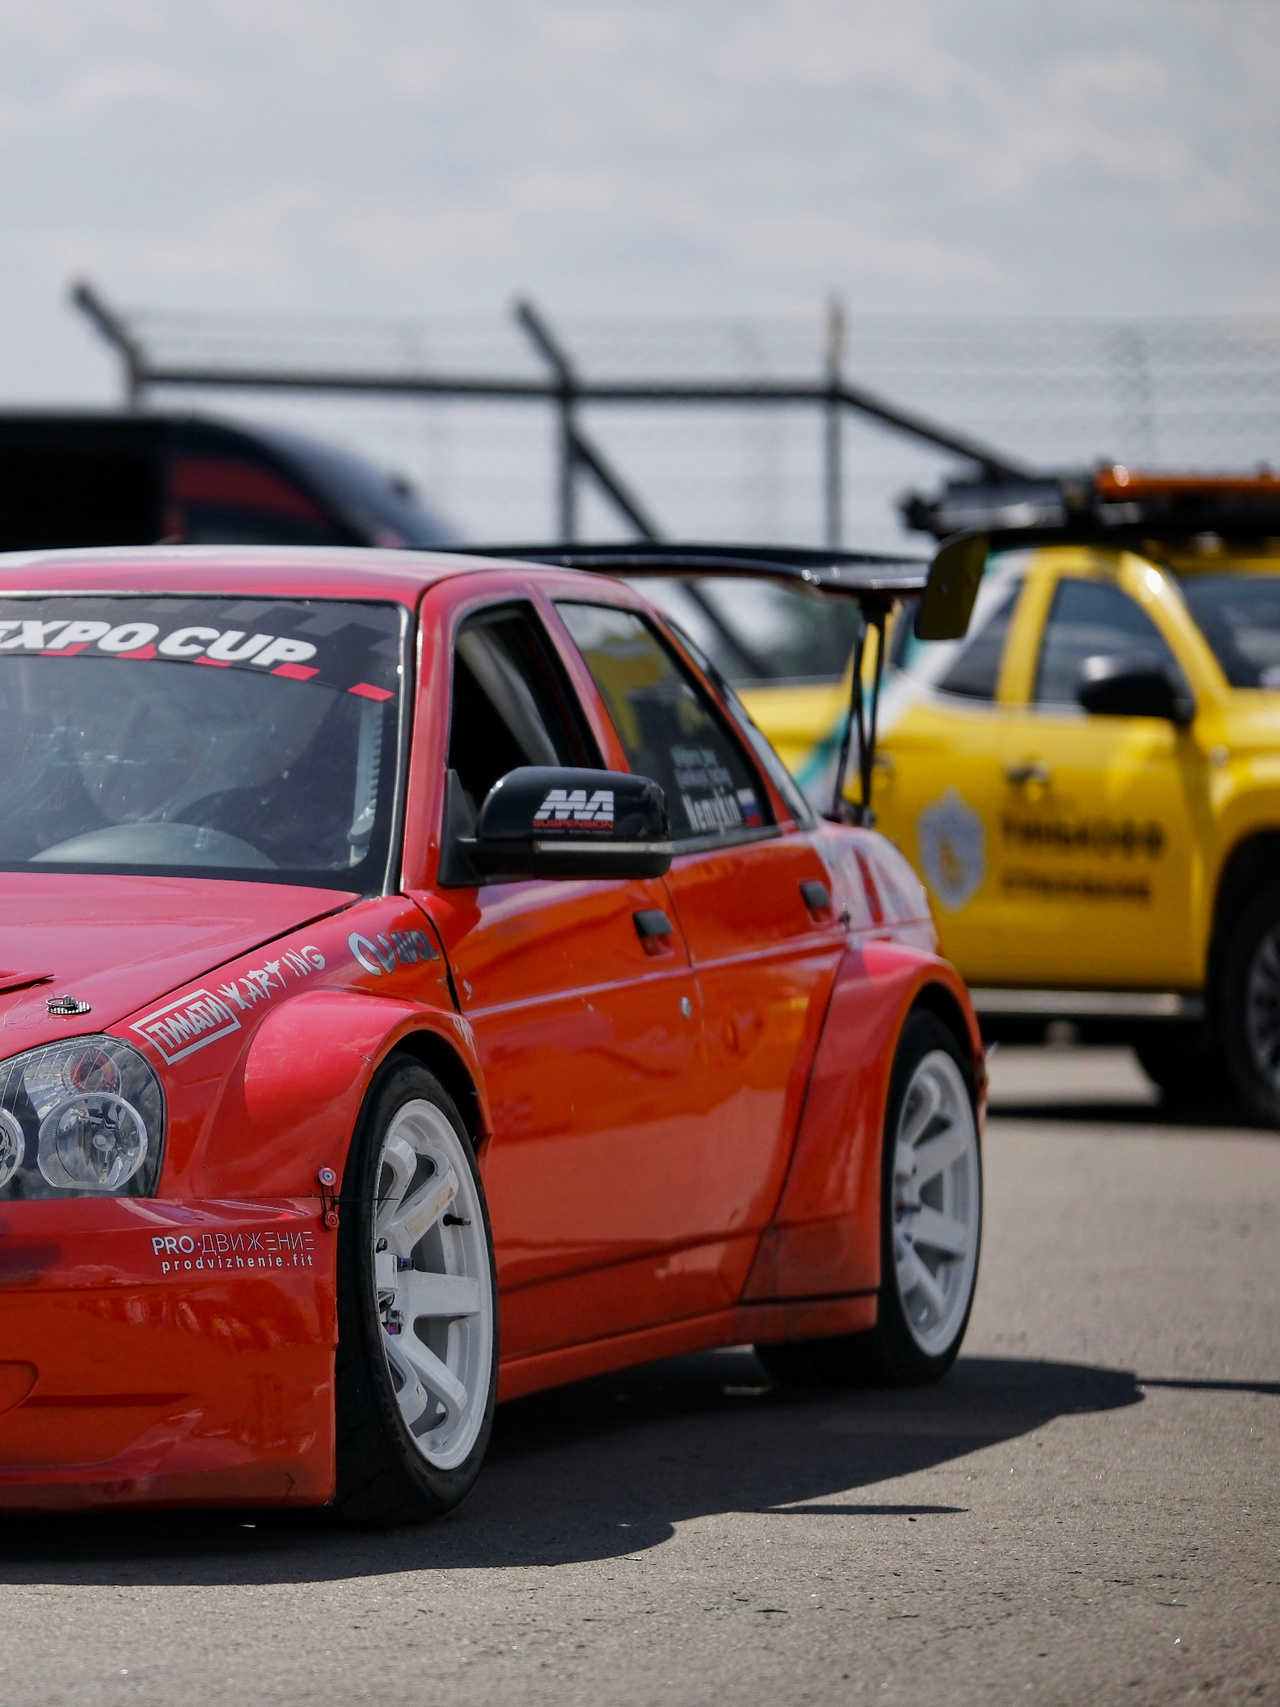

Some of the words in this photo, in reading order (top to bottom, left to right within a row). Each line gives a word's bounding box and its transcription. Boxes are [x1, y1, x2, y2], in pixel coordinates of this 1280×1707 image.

[158, 626, 317, 666] CUP
[533, 819, 614, 830] SUSPENSION
[216, 945, 326, 1010] KARTING
[161, 1254, 314, 1274] prodvizhenie.fit
